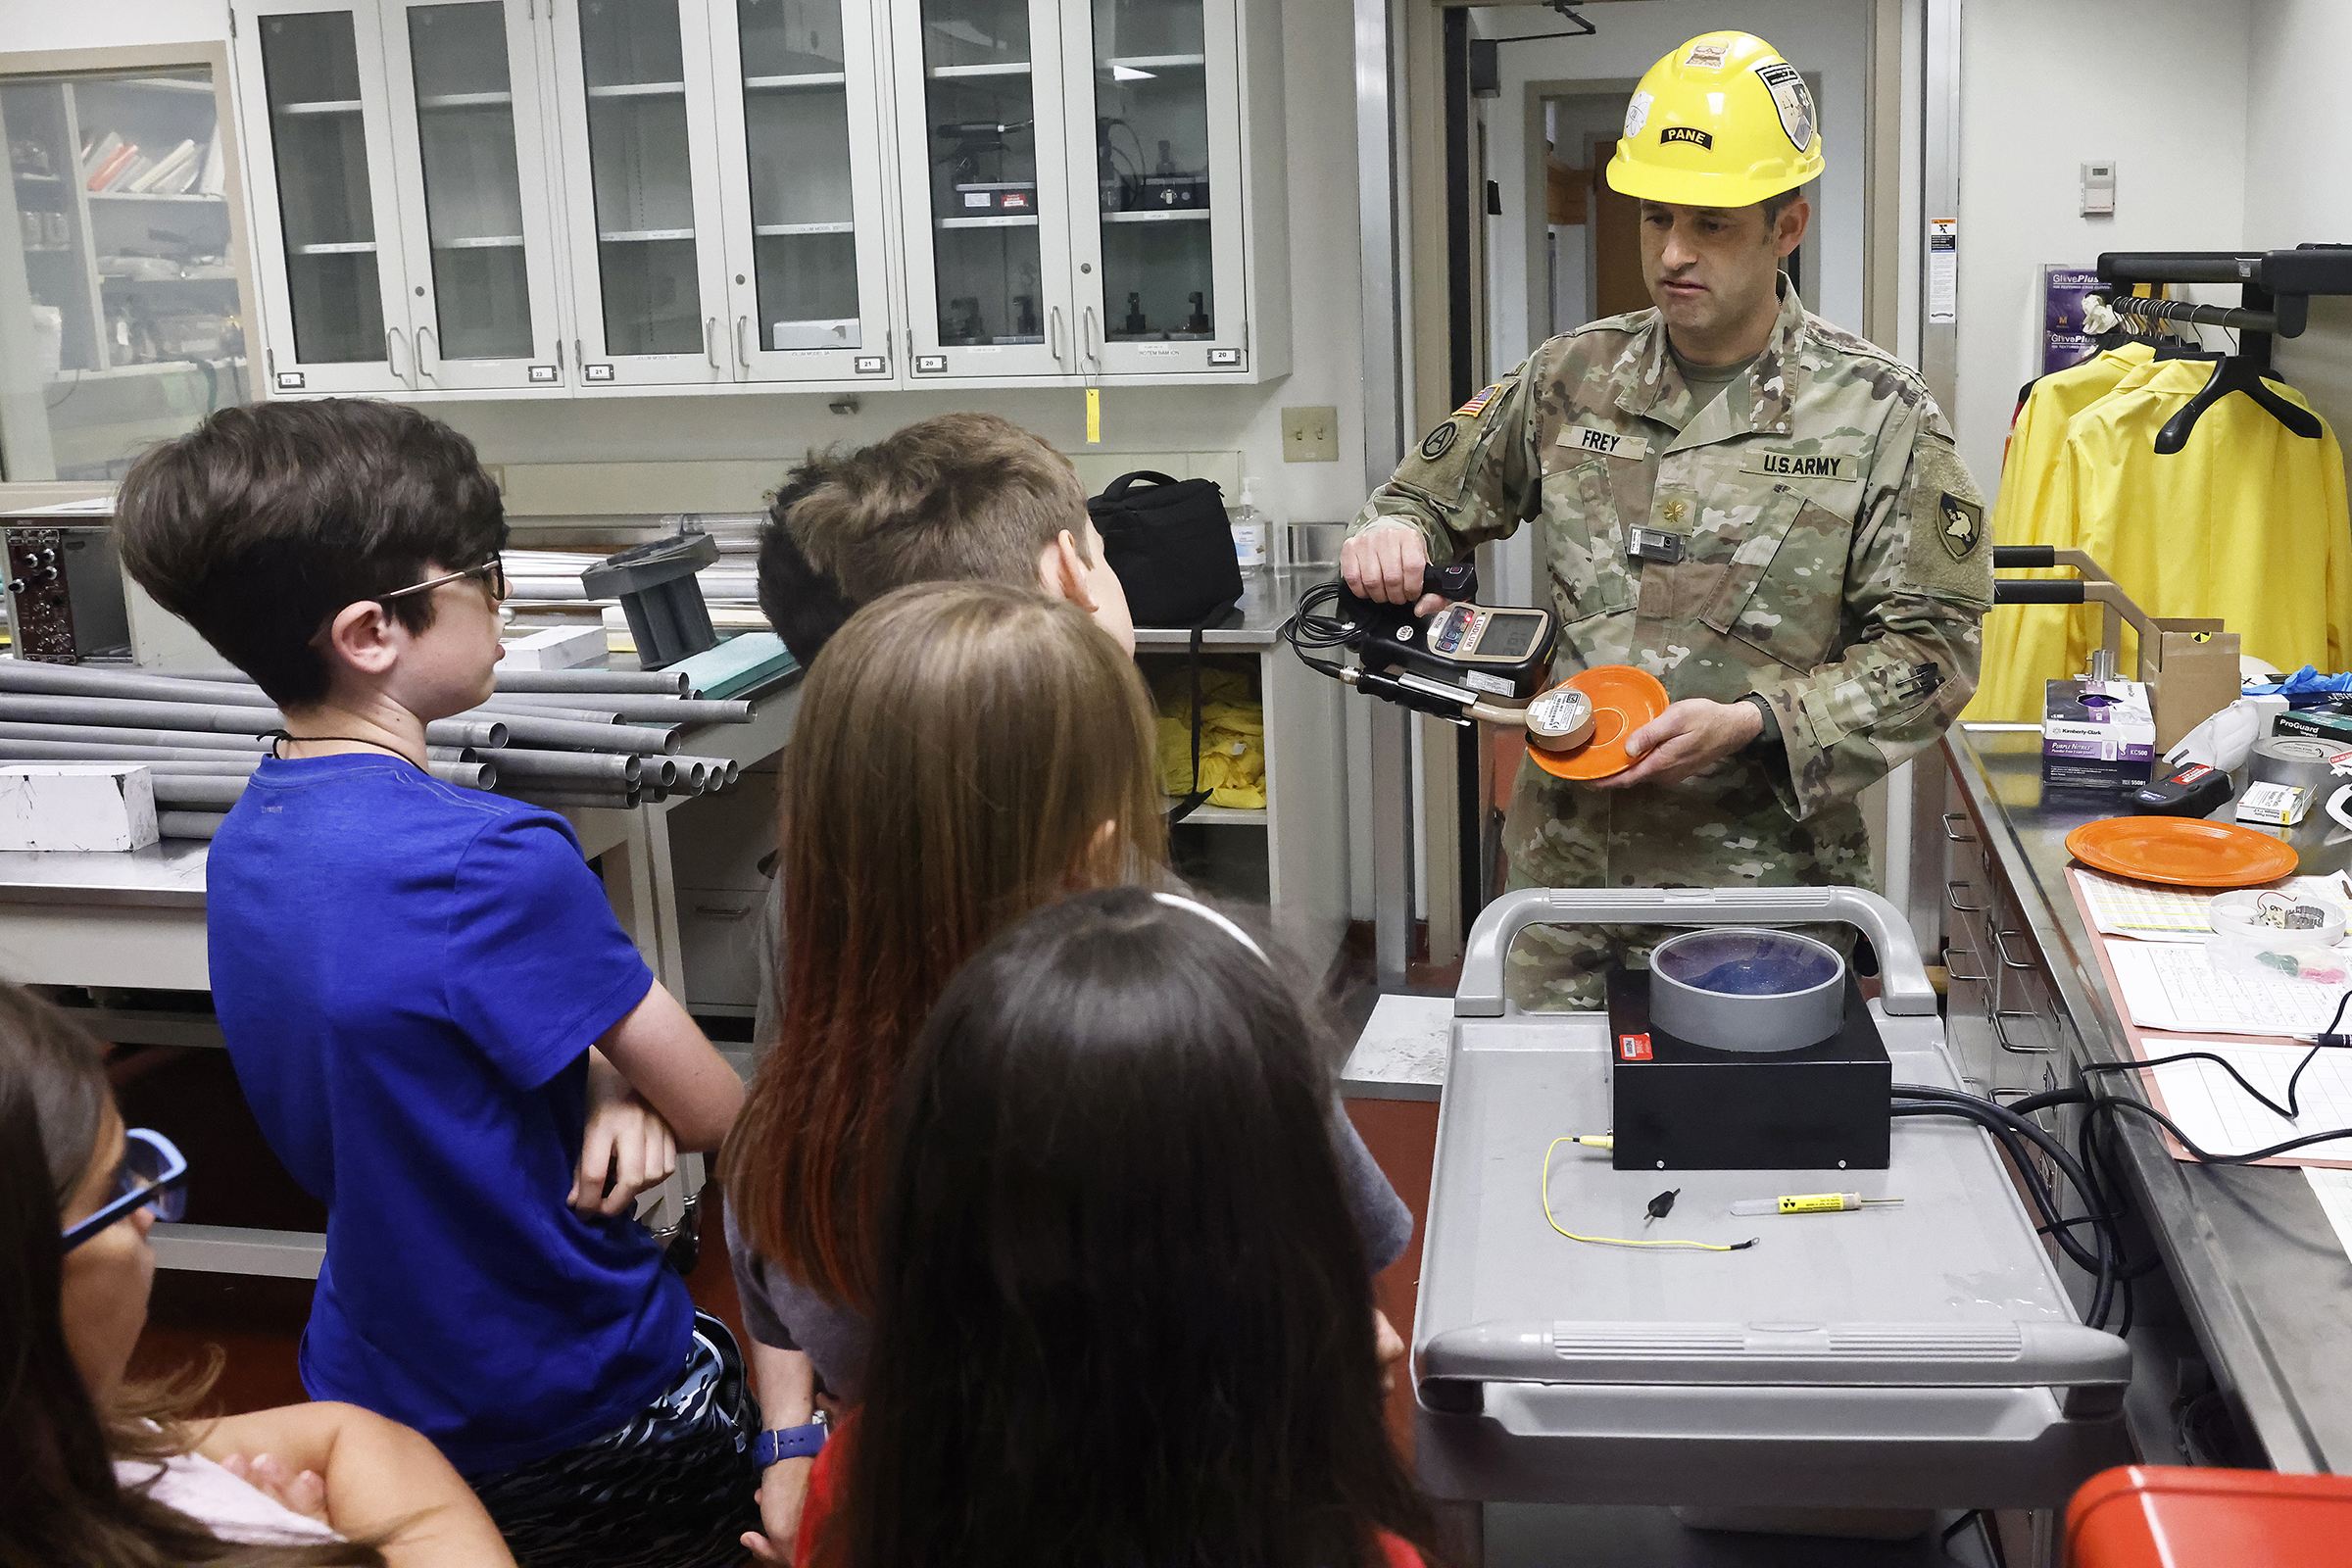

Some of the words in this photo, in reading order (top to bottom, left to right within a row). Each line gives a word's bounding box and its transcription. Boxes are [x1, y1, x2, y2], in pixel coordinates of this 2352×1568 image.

[1668, 128, 1706, 144] PANE
[1582, 429, 1621, 452] FREY
[1465, 619, 1484, 648] LUDLUM
[2279, 718, 2320, 734] ProGuard
